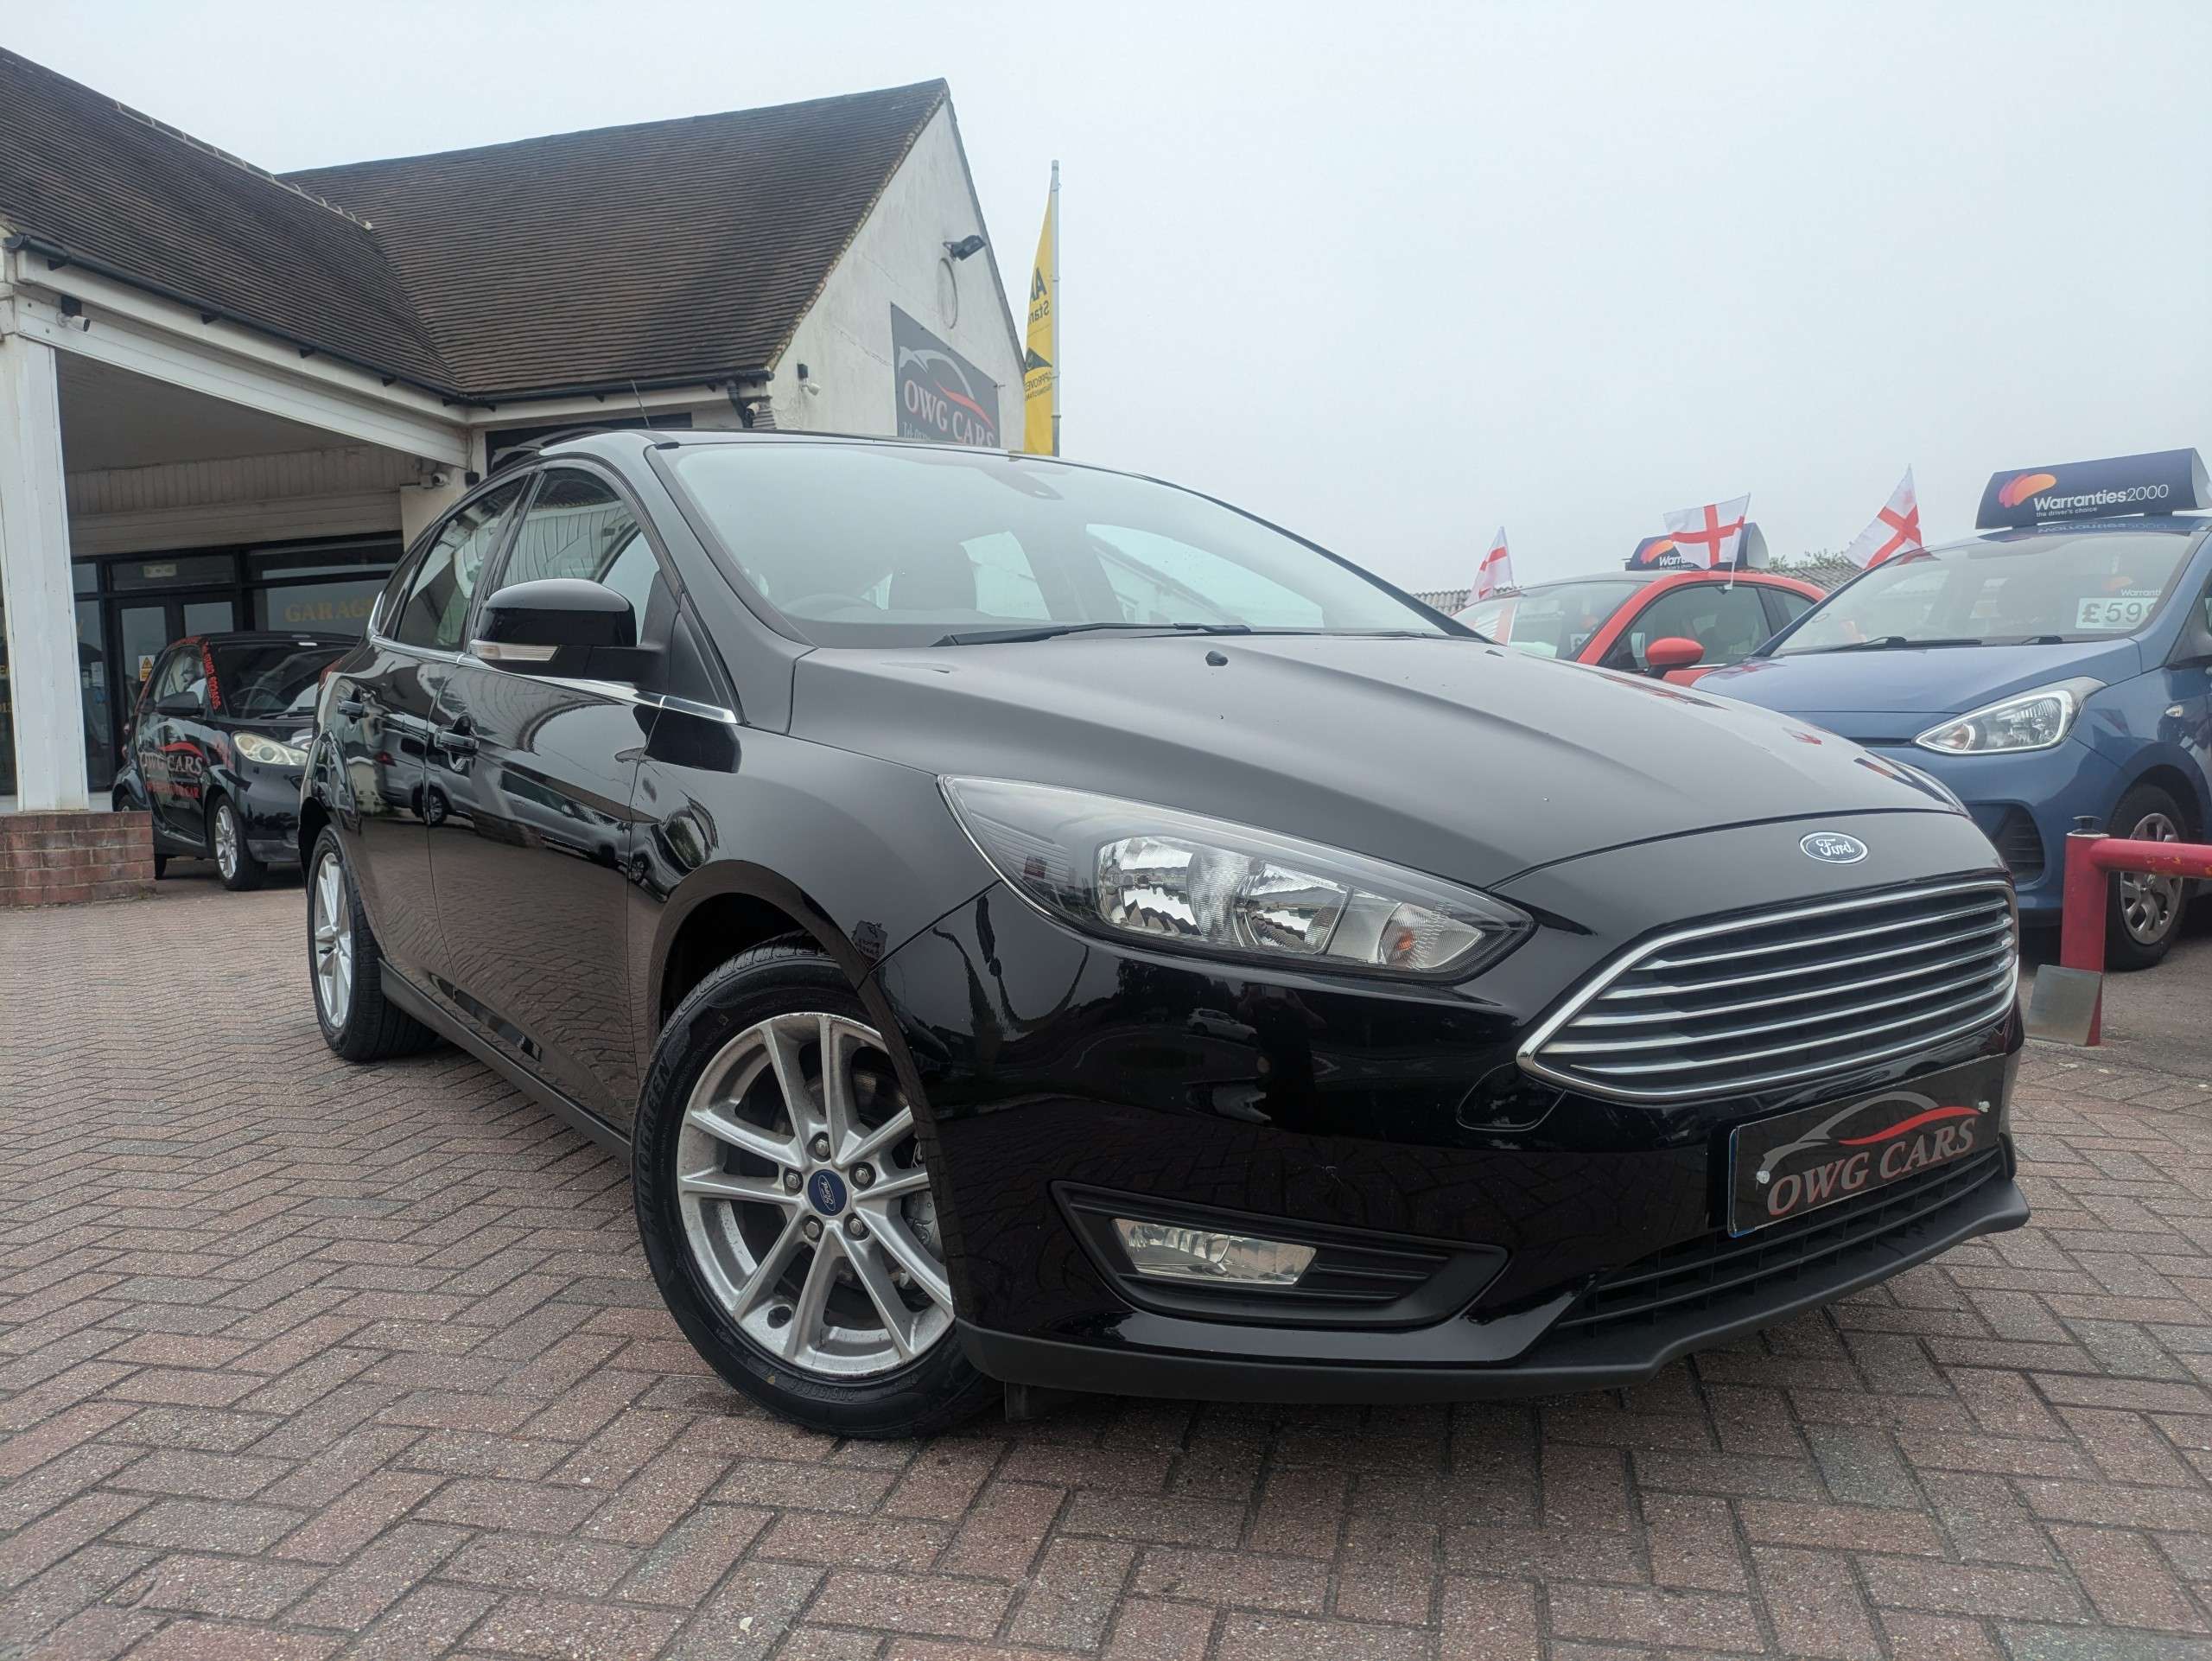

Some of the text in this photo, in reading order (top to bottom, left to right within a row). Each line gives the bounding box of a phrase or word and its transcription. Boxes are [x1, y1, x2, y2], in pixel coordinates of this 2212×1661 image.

[904, 379, 948, 432] OWG
[2033, 484, 2169, 511] Warranties2000
[167, 754, 203, 776] CARS
[1815, 838, 1855, 856] Ford
[1767, 1117, 1976, 1217] OWG CARS
